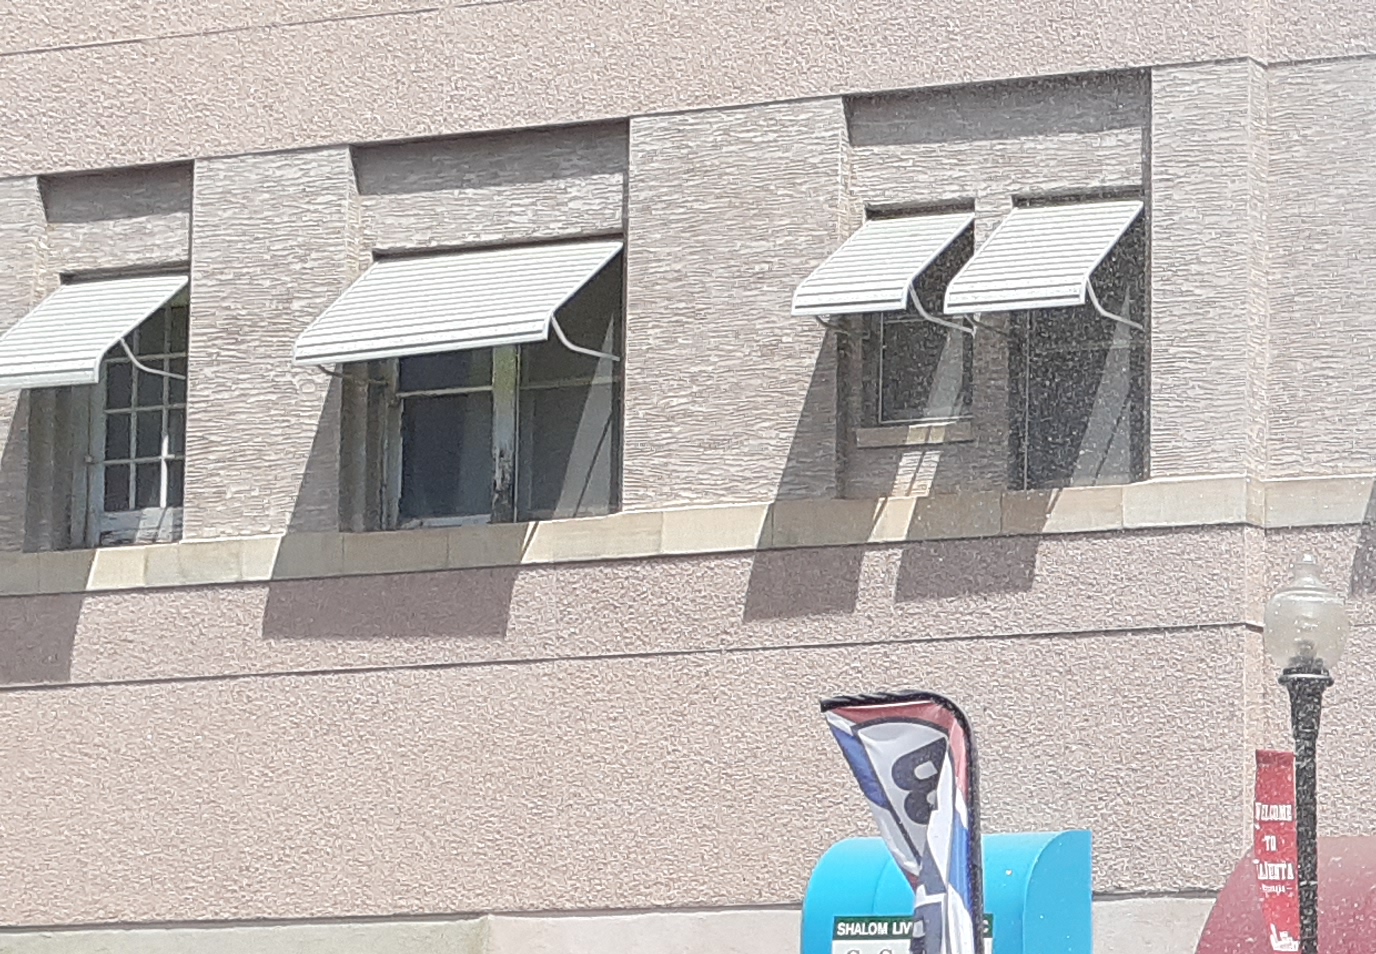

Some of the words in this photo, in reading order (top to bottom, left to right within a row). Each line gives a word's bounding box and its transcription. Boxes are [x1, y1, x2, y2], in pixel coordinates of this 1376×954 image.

[1264, 835, 1277, 851] TO
[837, 921, 888, 936] SHALOM
[892, 921, 912, 935] LIV
